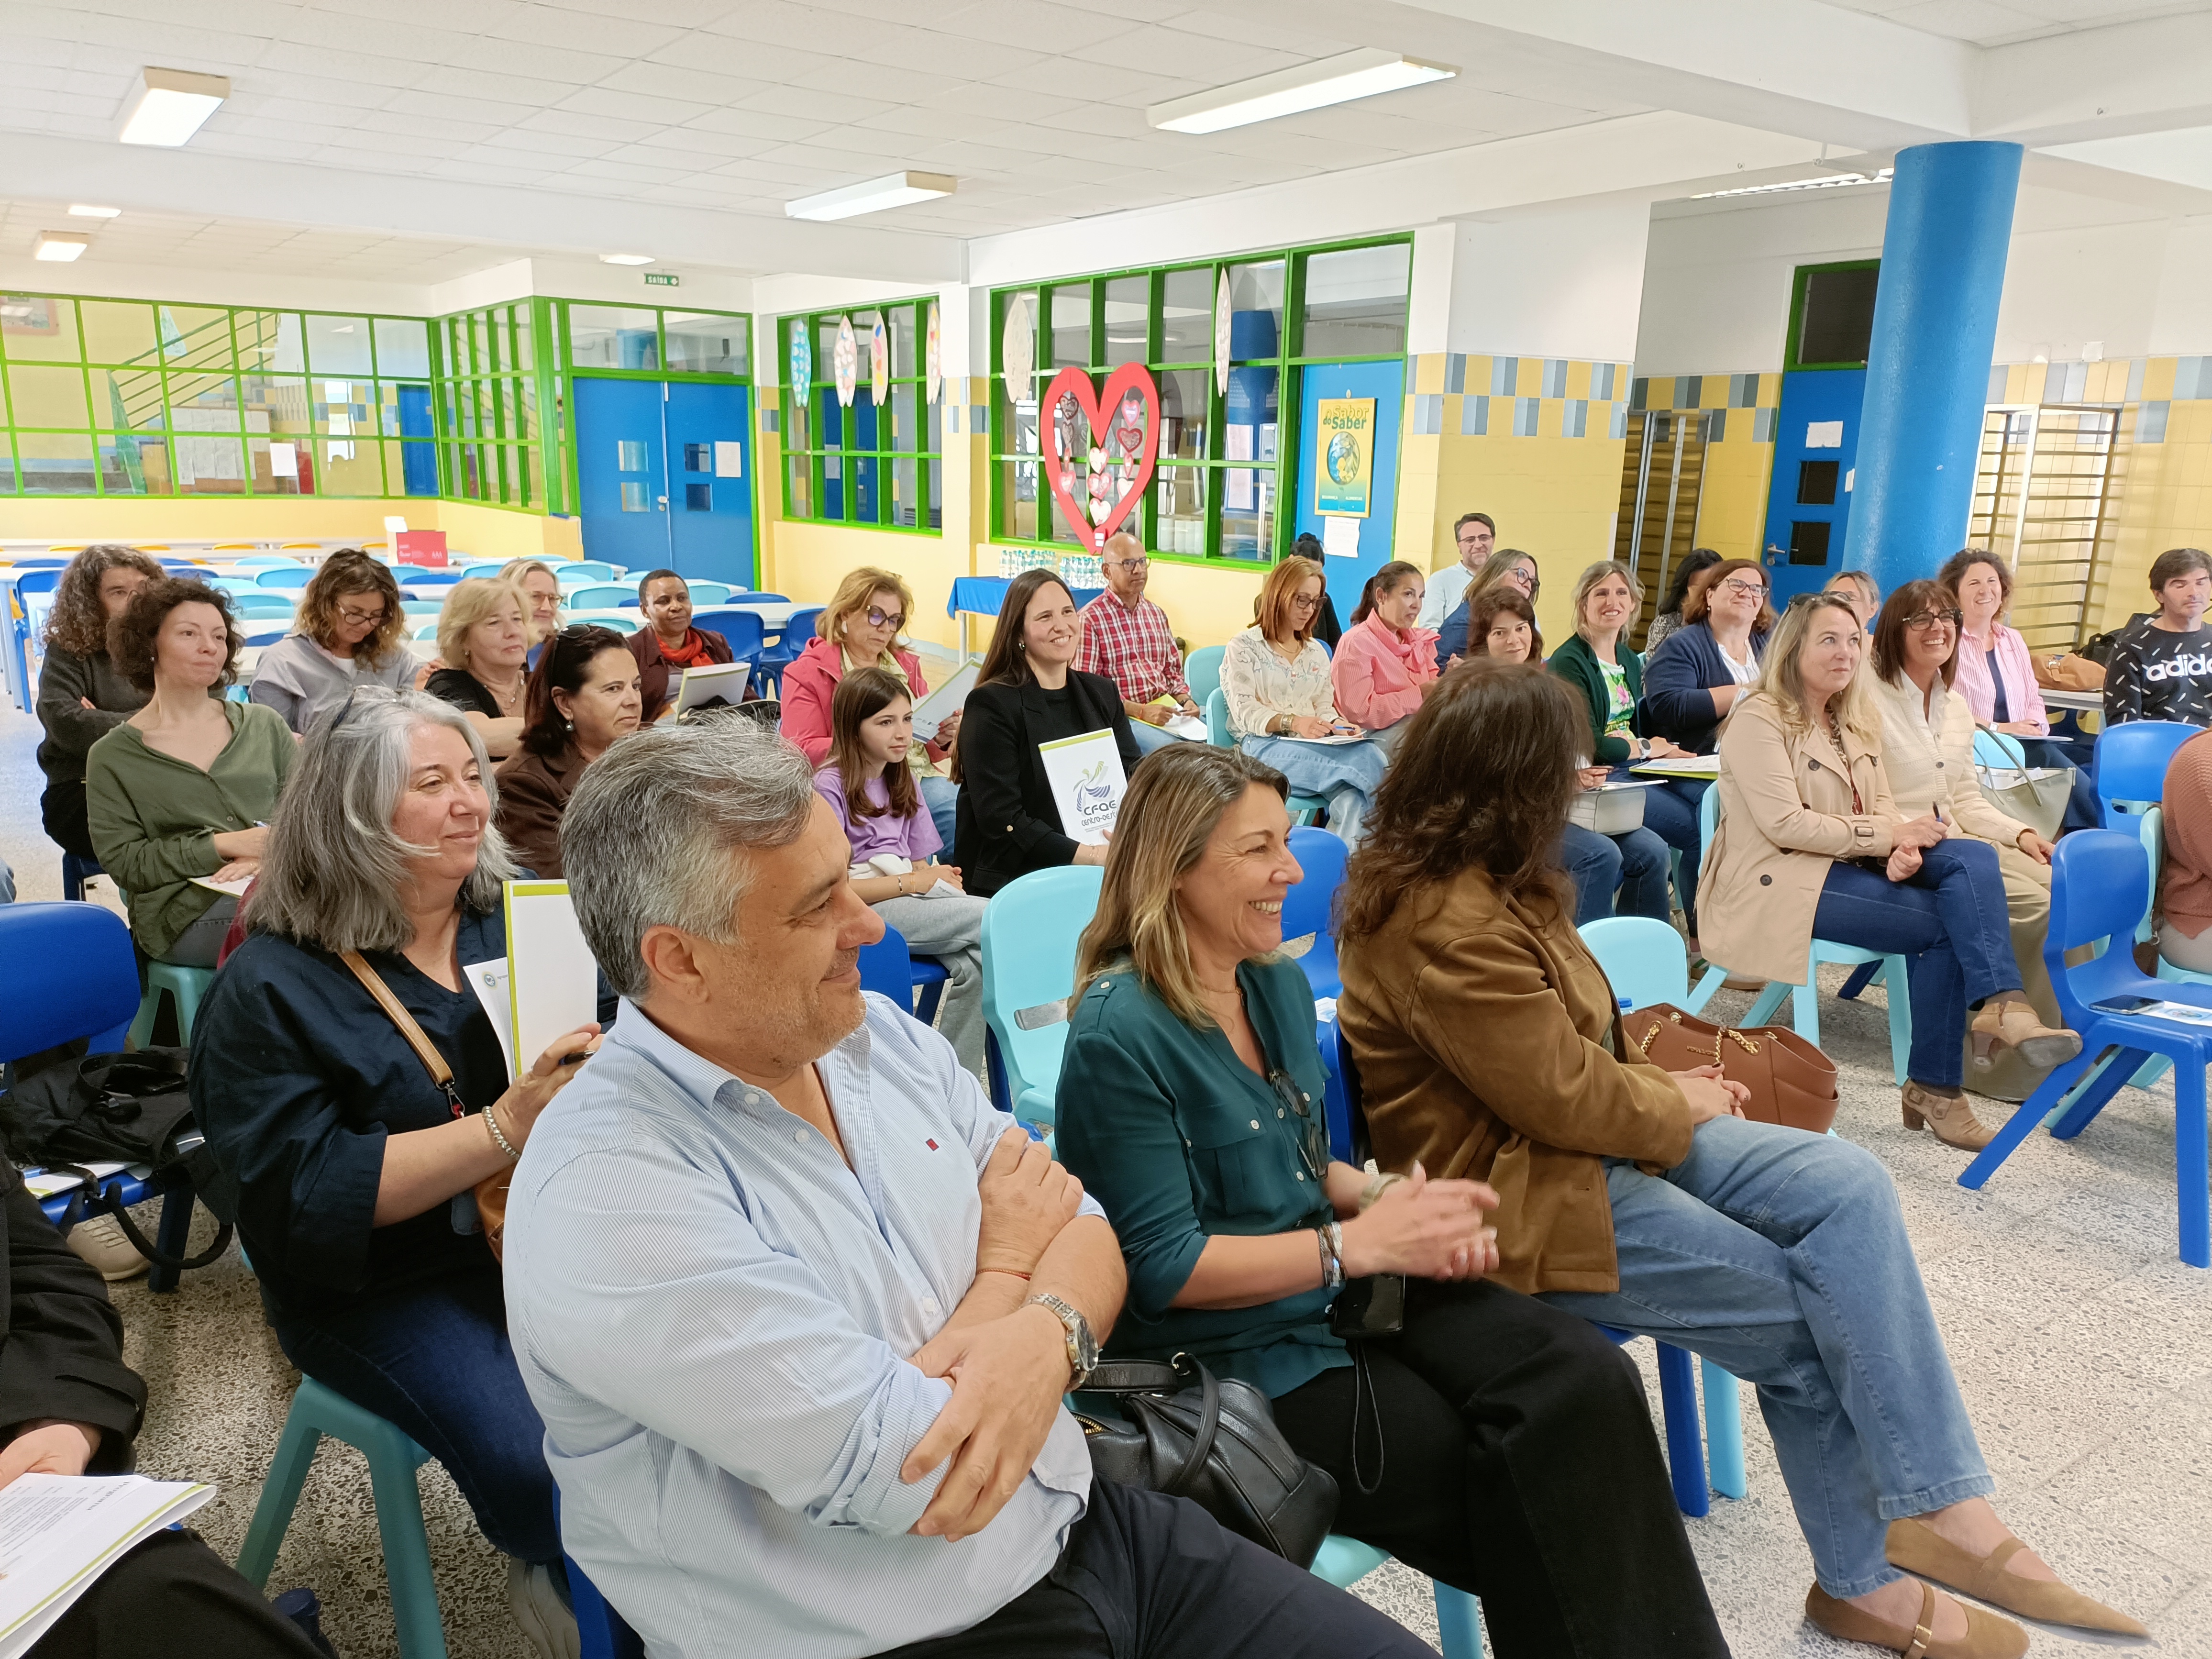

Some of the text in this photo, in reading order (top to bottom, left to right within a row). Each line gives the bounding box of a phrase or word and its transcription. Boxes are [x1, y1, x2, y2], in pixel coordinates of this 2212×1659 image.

[1333, 404, 1369, 420] Sabor
[1323, 416, 1367, 430] do Saber
